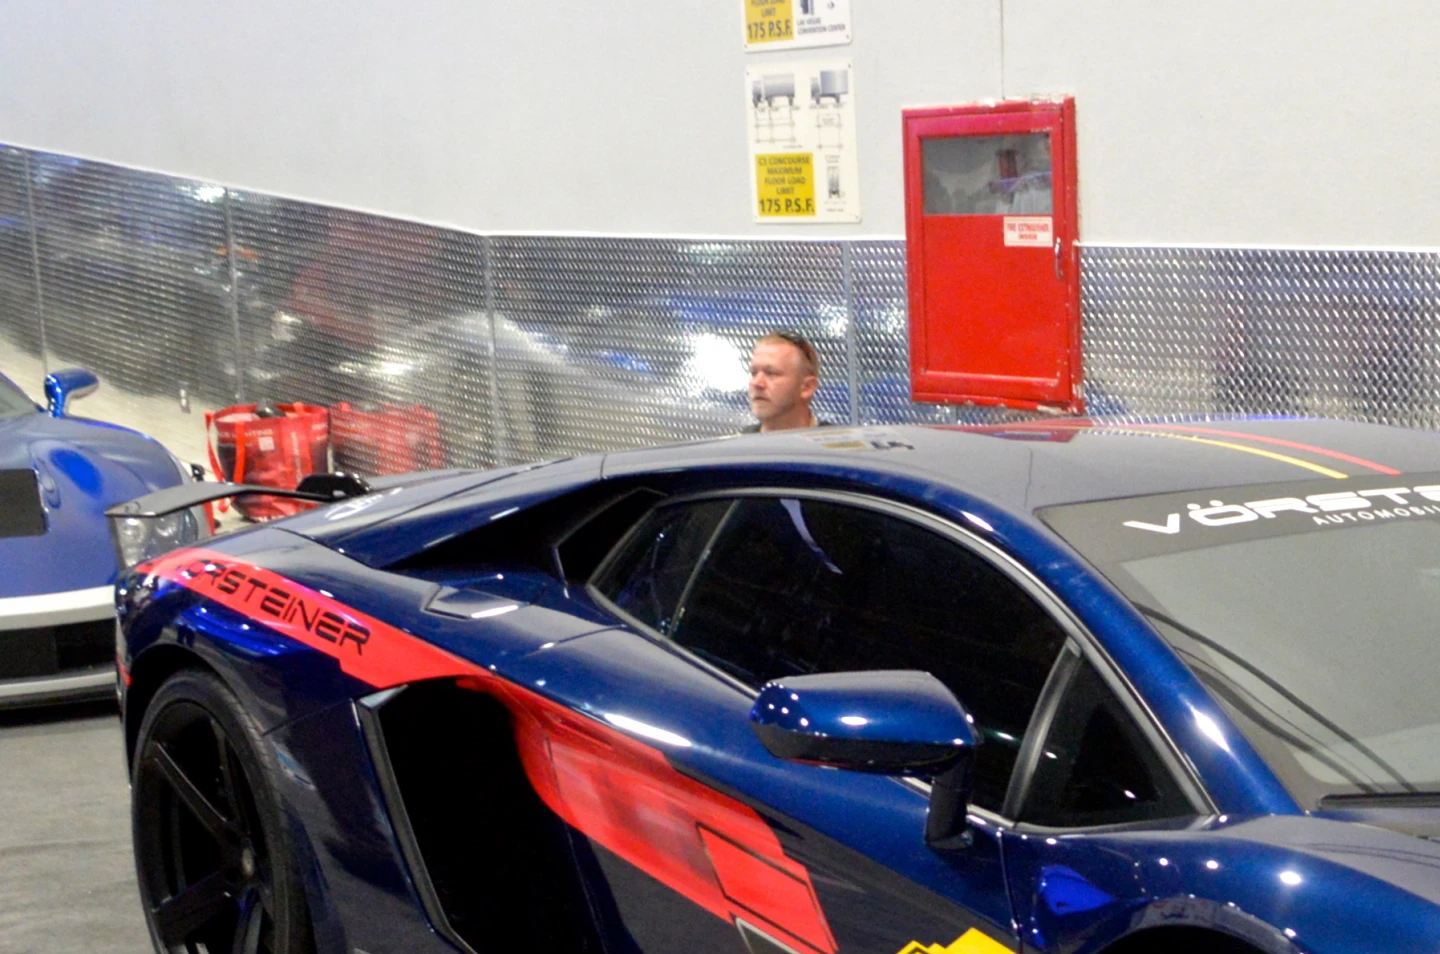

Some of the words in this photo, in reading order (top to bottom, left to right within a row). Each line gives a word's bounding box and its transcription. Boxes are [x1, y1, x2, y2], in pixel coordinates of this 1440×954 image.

[748, 22, 766, 39] 175
[768, 19, 793, 37] P.S.F.
[828, 23, 846, 33] CENTER
[768, 156, 810, 166] CONCOURSE
[767, 166, 802, 175] MAXIMUM
[765, 177, 786, 185] FLOOR
[787, 176, 807, 185] LOAD
[776, 187, 795, 195] LIMIT
[759, 198, 782, 213] 175
[785, 198, 815, 213] P.S.F.
